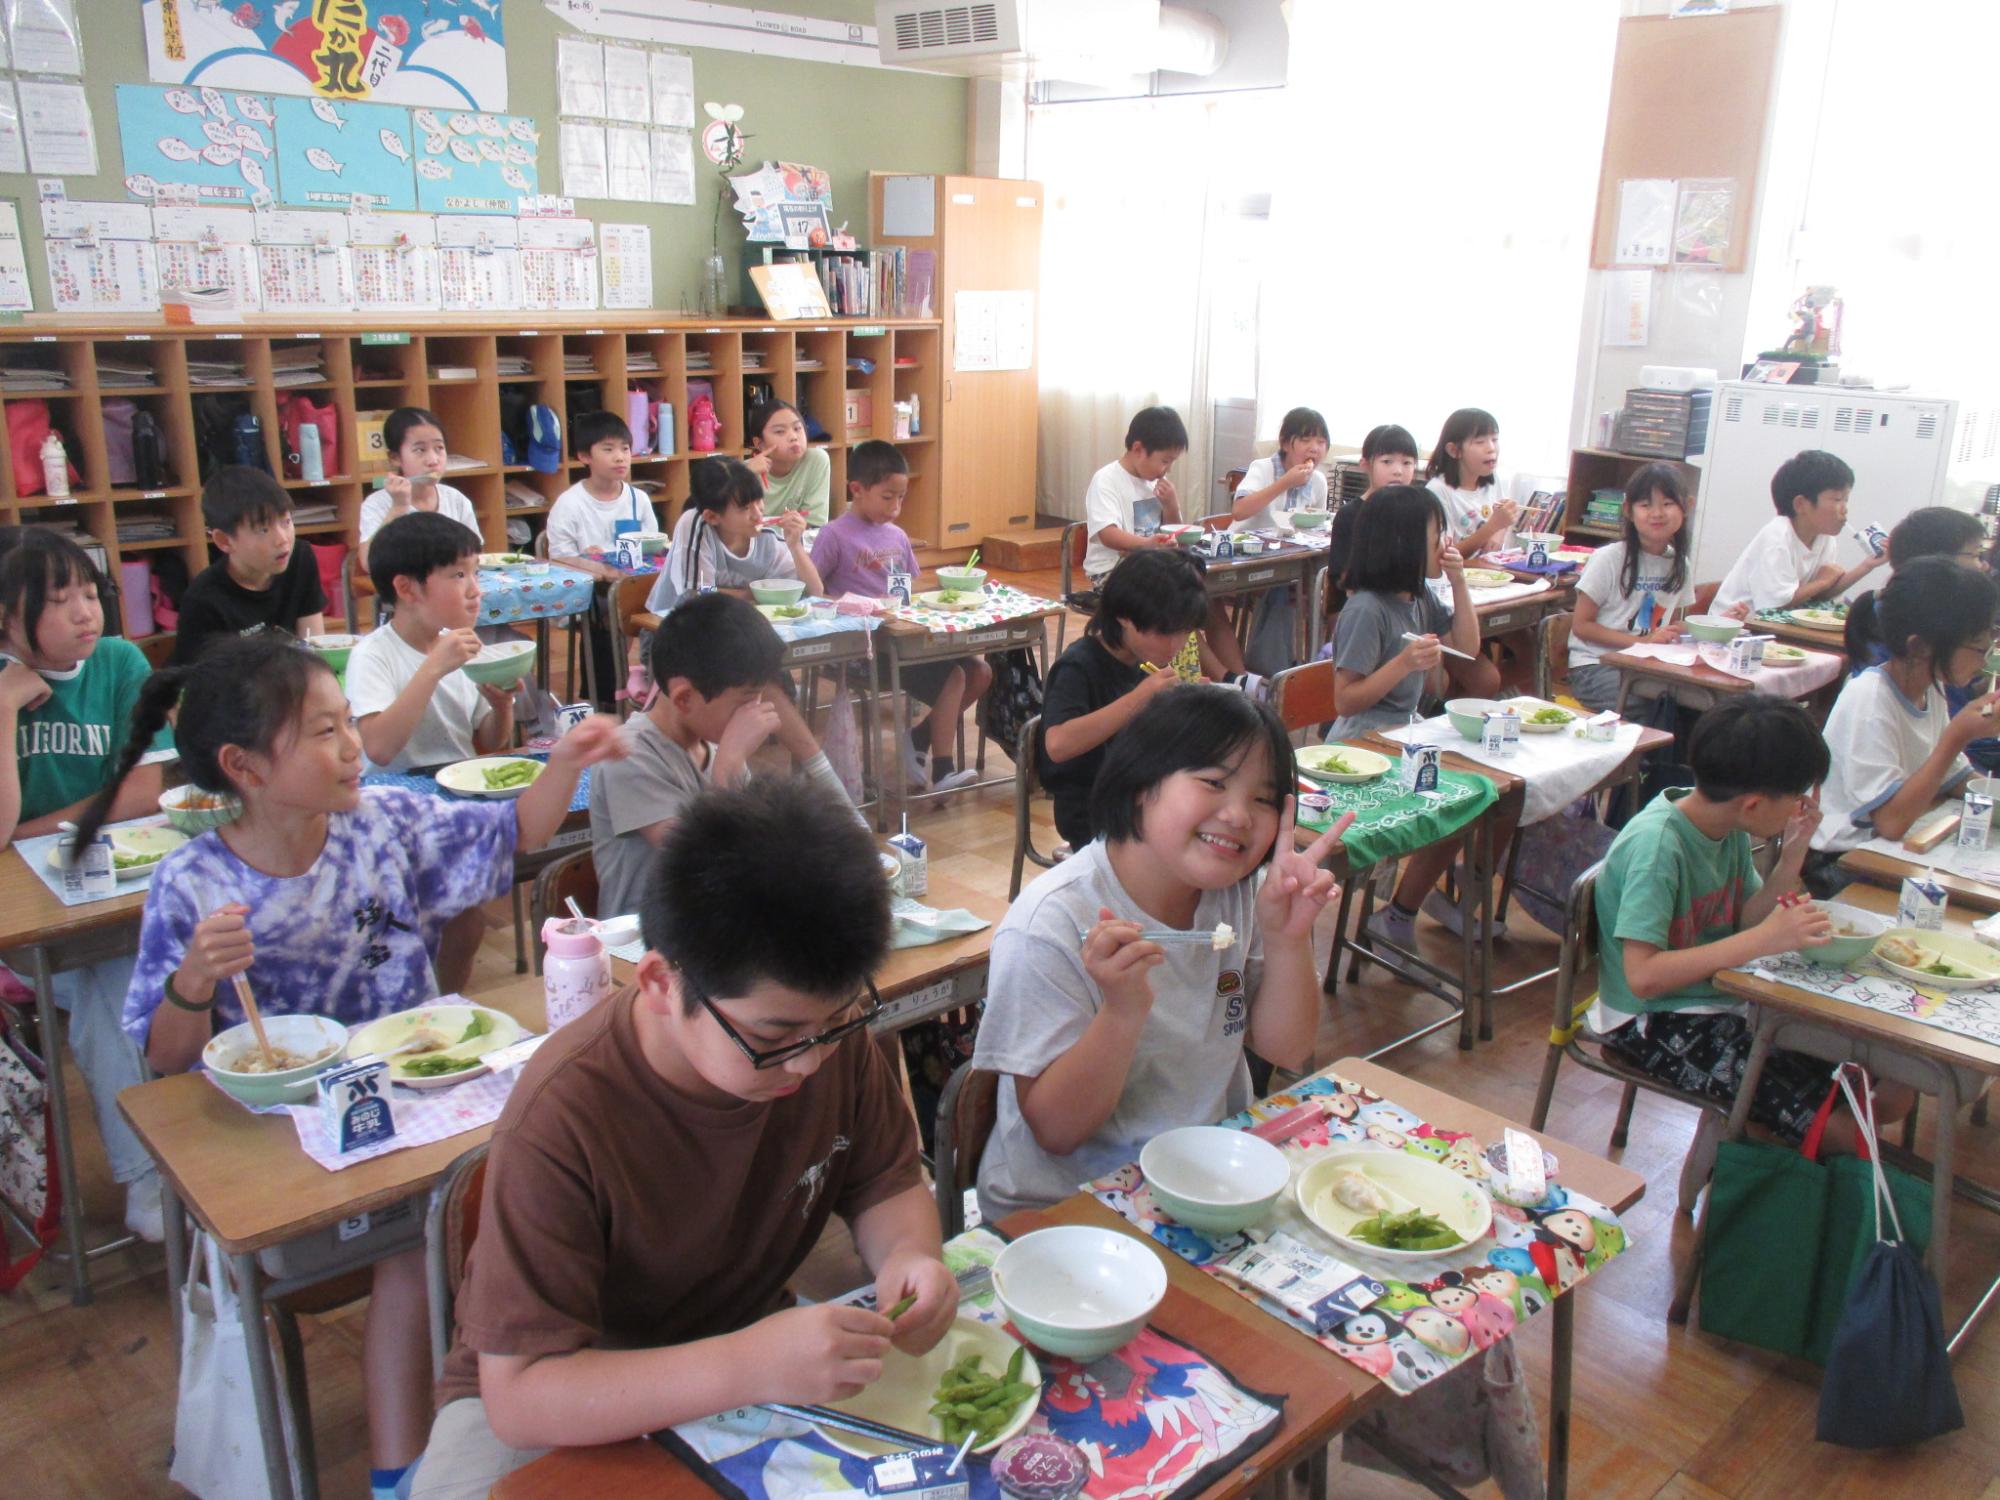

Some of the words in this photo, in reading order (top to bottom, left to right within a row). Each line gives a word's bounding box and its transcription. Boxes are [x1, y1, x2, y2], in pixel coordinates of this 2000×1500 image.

[369, 45, 393, 88] 二代目
[370, 432, 383, 449] 3
[1228, 996, 1242, 1018] S
[352, 1117, 383, 1133] 牛乳
